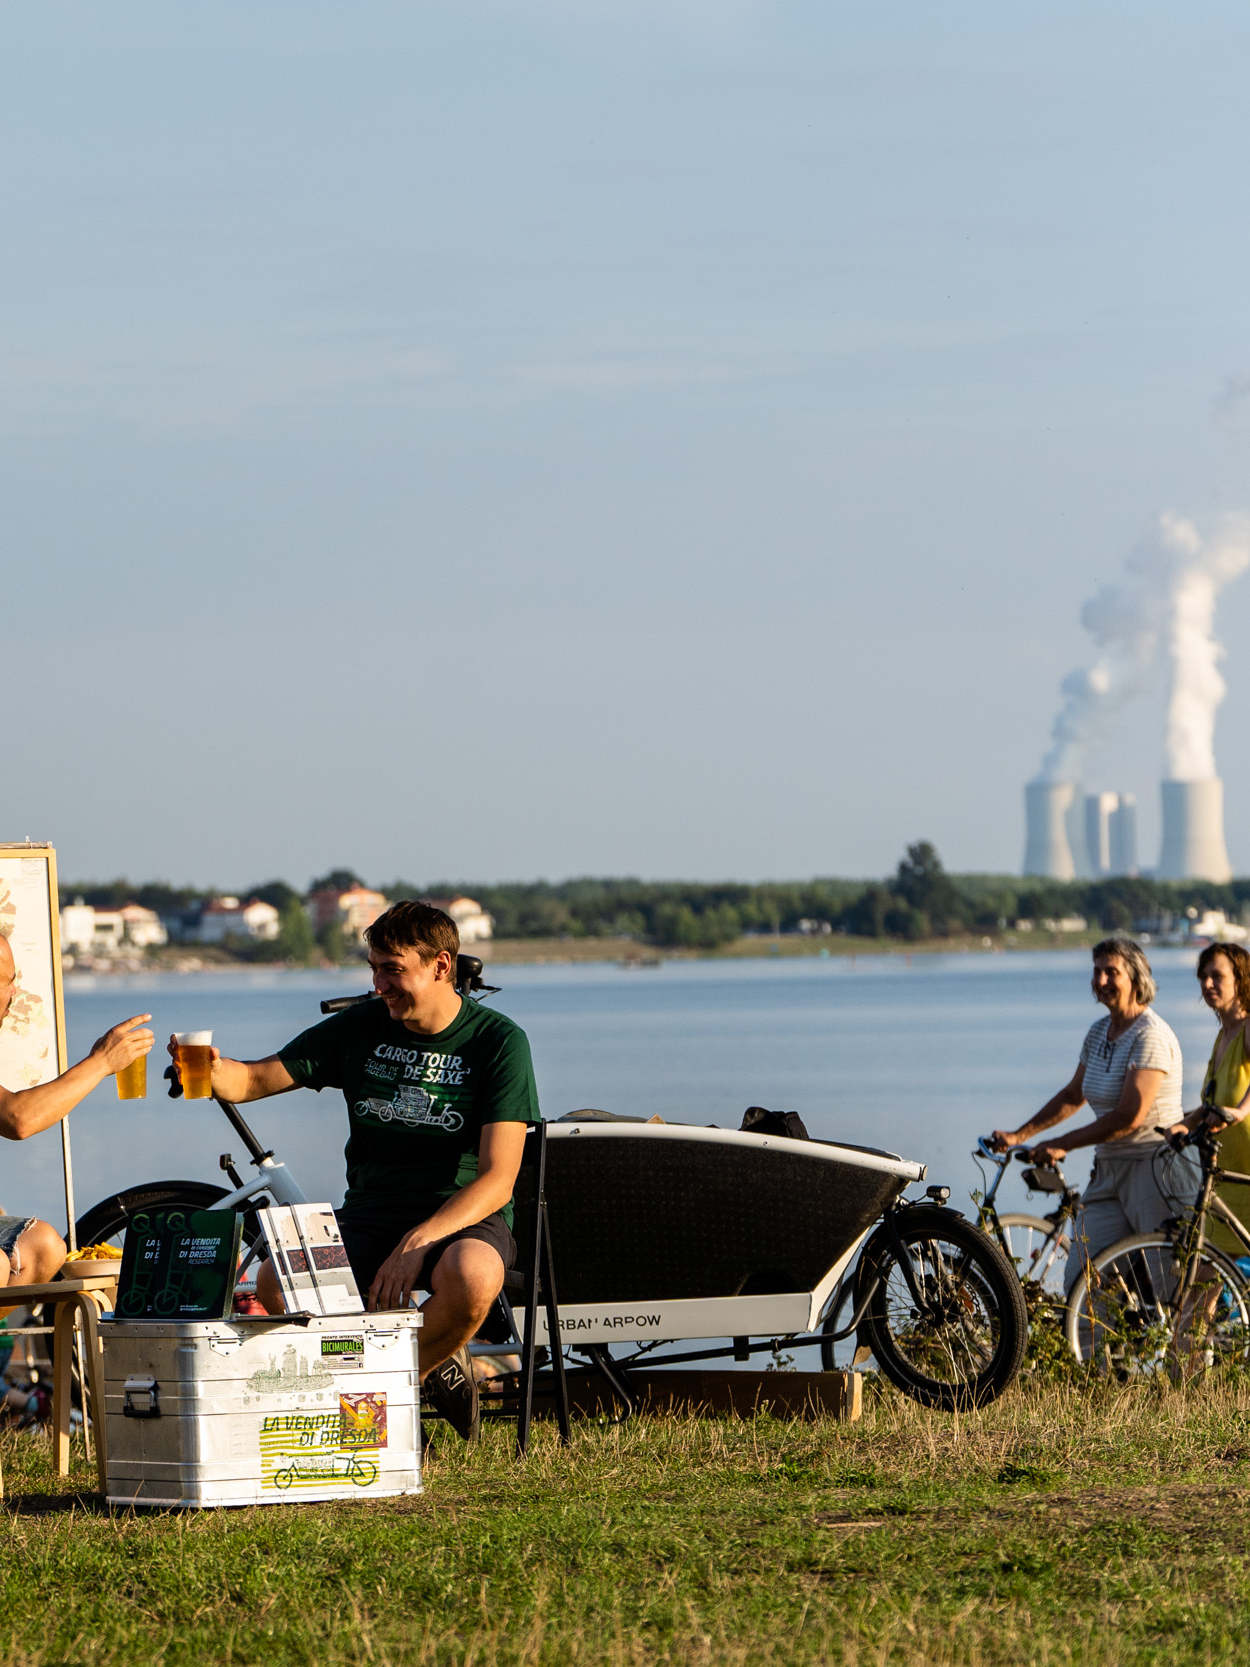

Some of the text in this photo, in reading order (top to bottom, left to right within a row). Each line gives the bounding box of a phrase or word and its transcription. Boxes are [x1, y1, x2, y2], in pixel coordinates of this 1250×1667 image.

[374, 1043, 463, 1071] CARGO TOUR
[403, 1064, 424, 1081] DE
[180, 1238, 221, 1246] LA VENDITA
[322, 1341, 363, 1353] BICIMURALES
[262, 1413, 347, 1431] LA VENDITA
[299, 1428, 378, 1446] DI DRESDA
